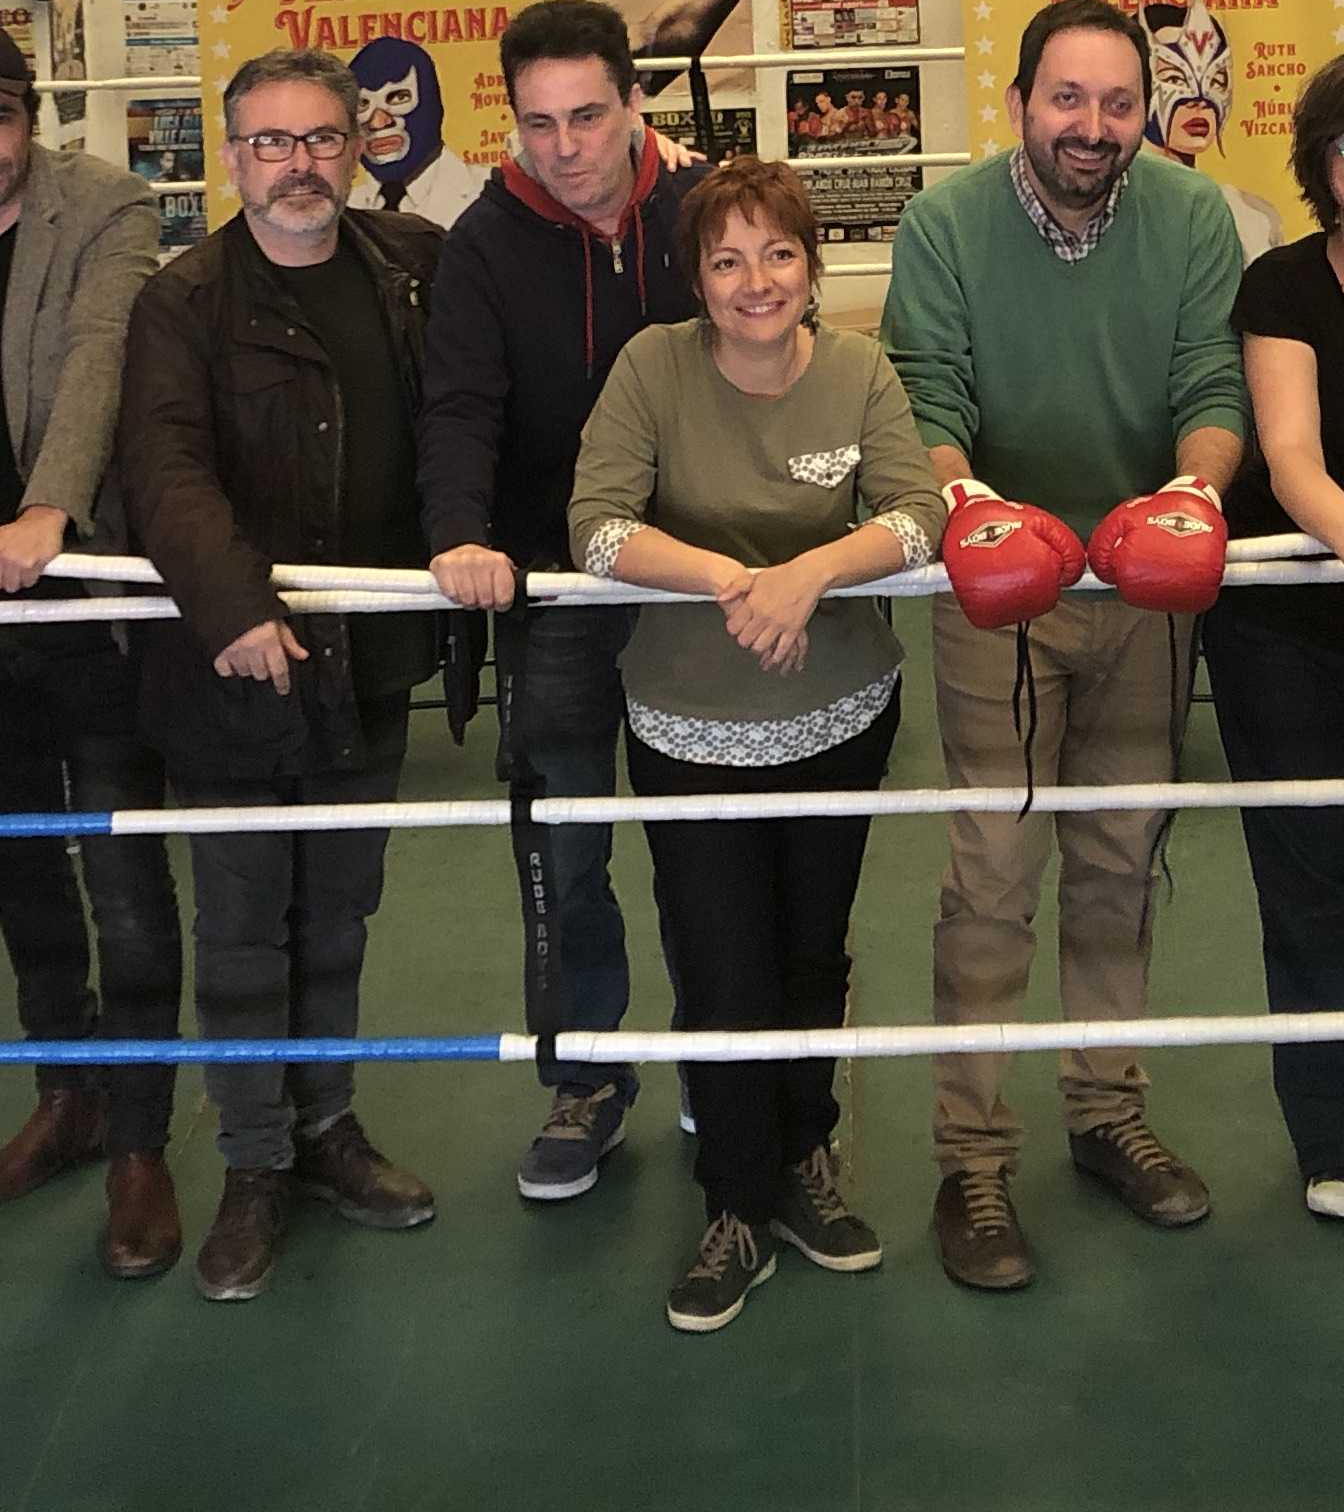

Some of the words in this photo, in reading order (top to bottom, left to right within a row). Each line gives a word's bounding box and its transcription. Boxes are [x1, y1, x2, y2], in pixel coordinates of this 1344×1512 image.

[274, 5, 512, 50] VALENCIANA
[1254, 41, 1296, 60] RUTH
[1246, 61, 1307, 79] SANCHO
[652, 111, 724, 126] BOXO
[529, 852, 548, 915] RUDE
